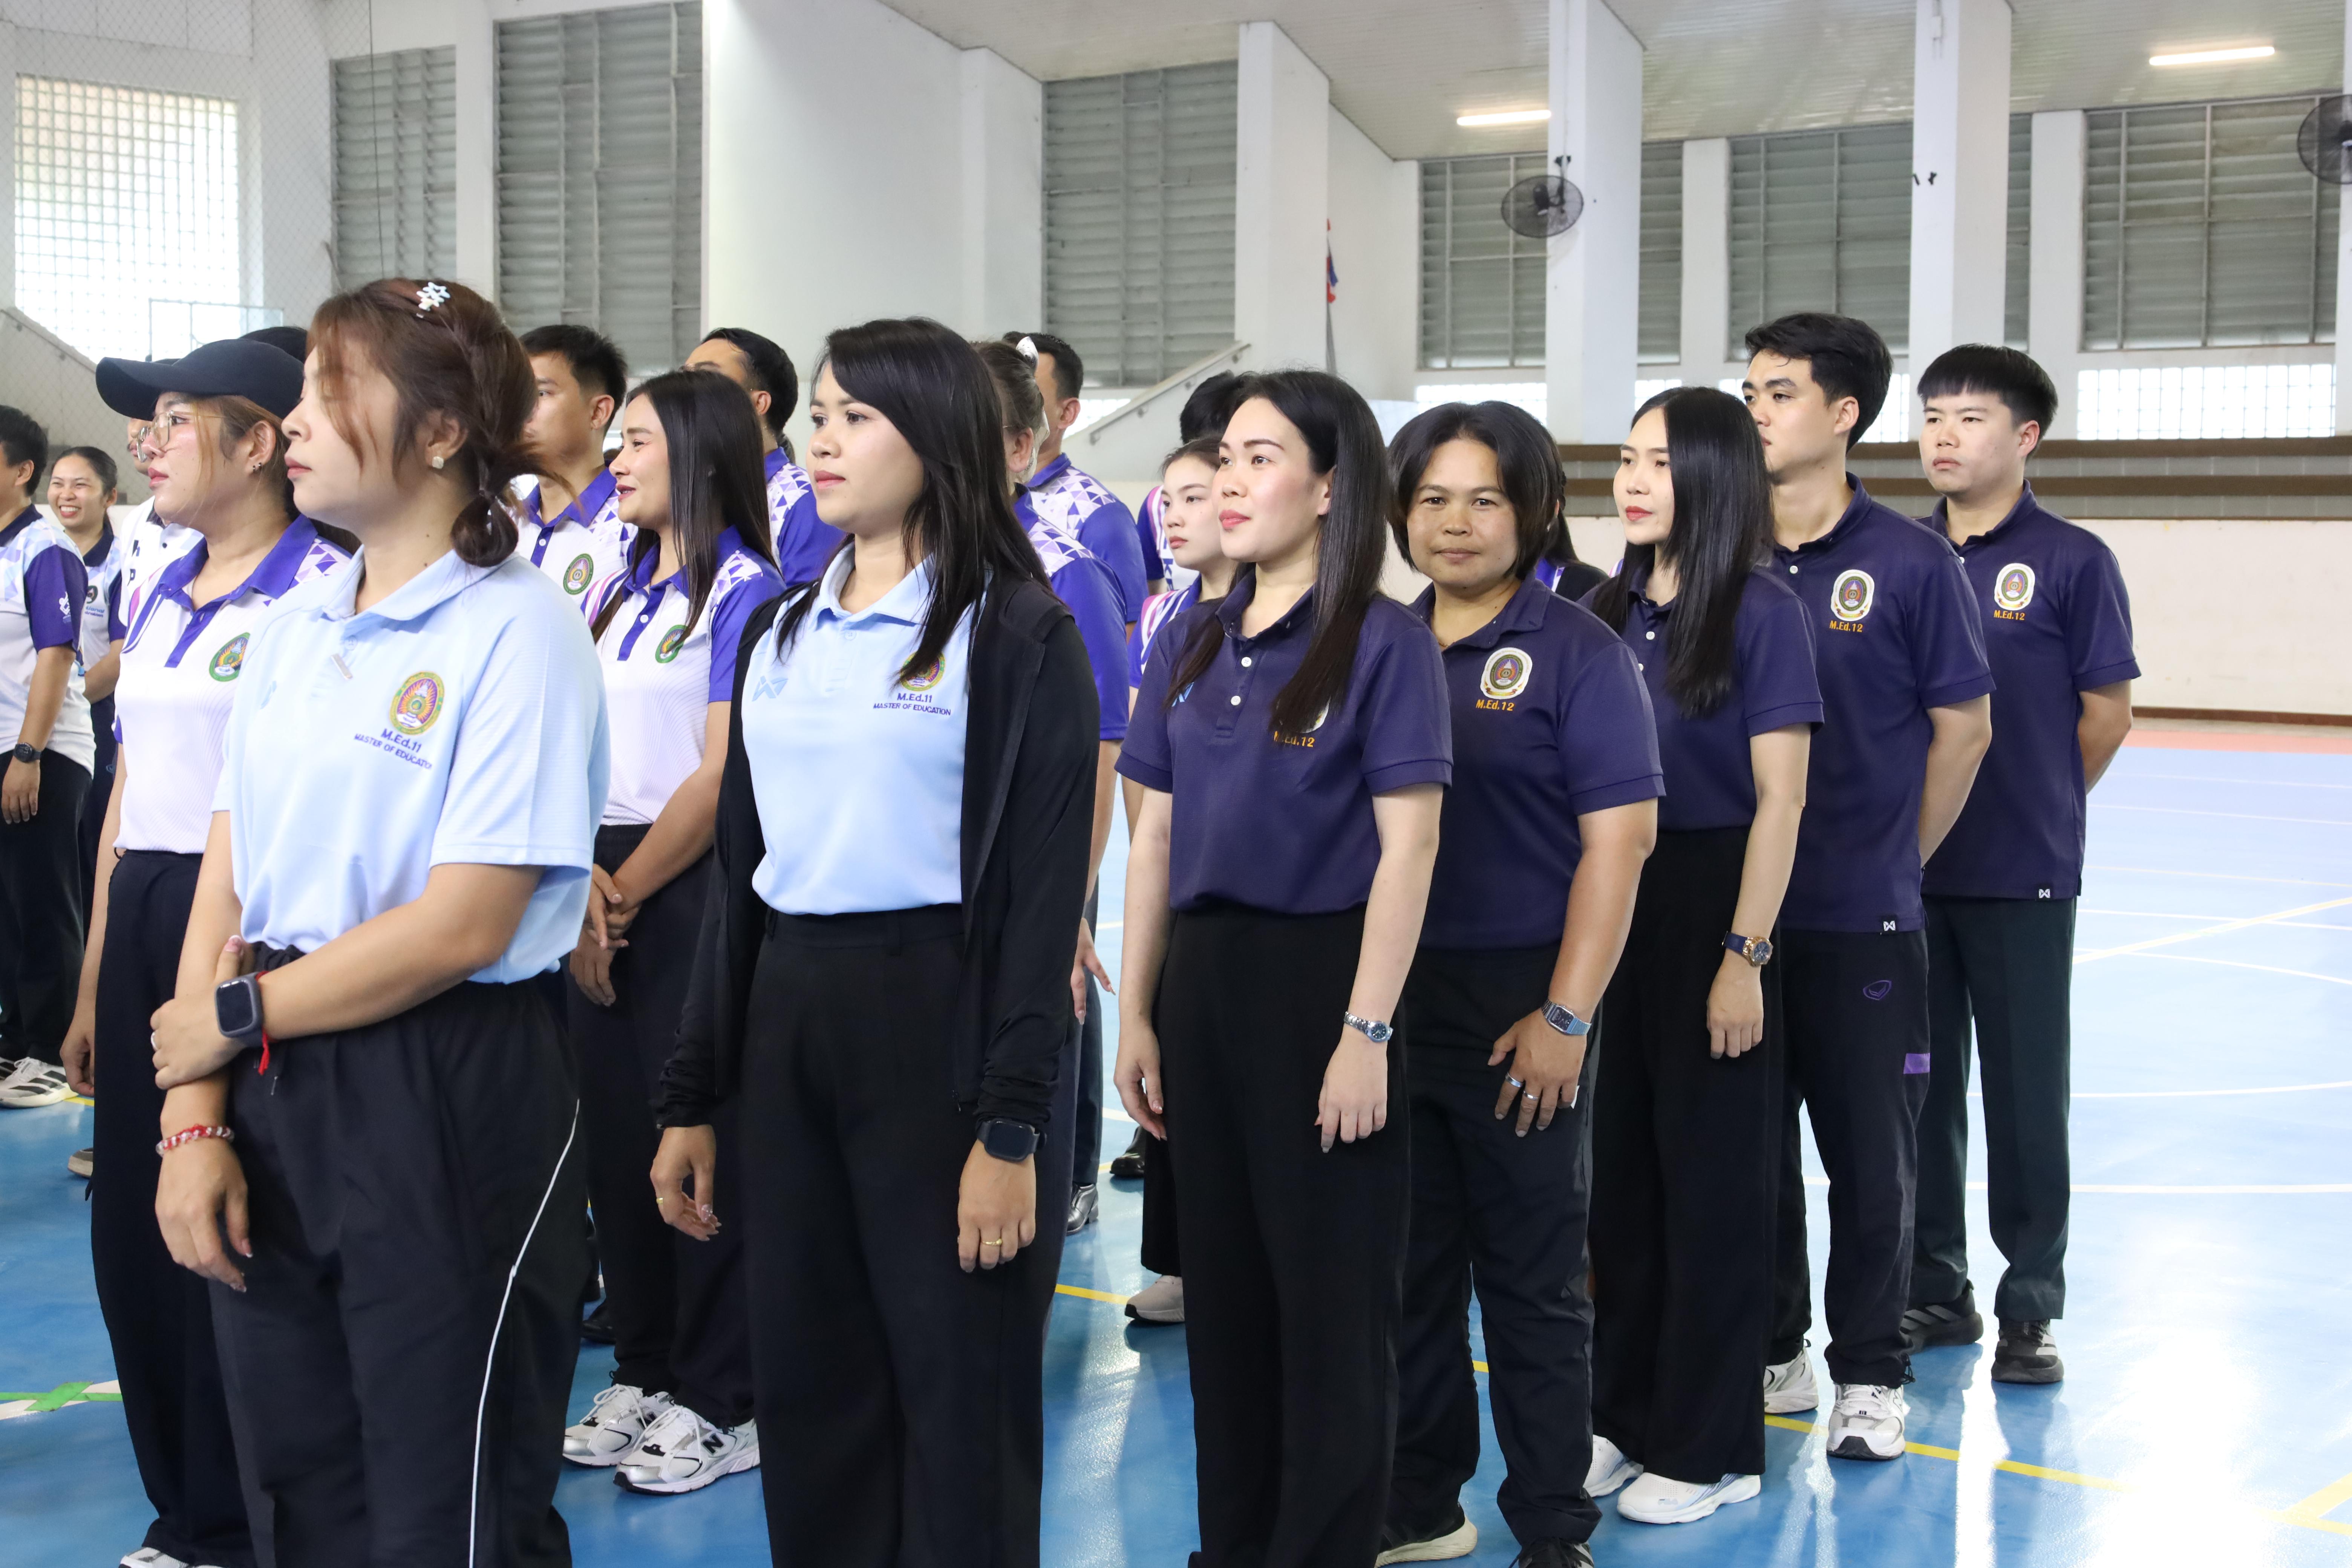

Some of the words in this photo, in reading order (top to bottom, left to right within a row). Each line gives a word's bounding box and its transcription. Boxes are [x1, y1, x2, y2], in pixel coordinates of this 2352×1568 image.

[1994, 609, 2025, 620] M.Ed.12
[1829, 620, 1863, 632] M.Ed.12
[897, 693, 932, 703] M.Ed.11
[913, 704, 951, 715] EDUCATION
[1476, 699, 1514, 711] M.Ed.12
[354, 733, 382, 748] MASTER
[384, 744, 394, 752] OF
[381, 728, 422, 753] M.Ed.11
